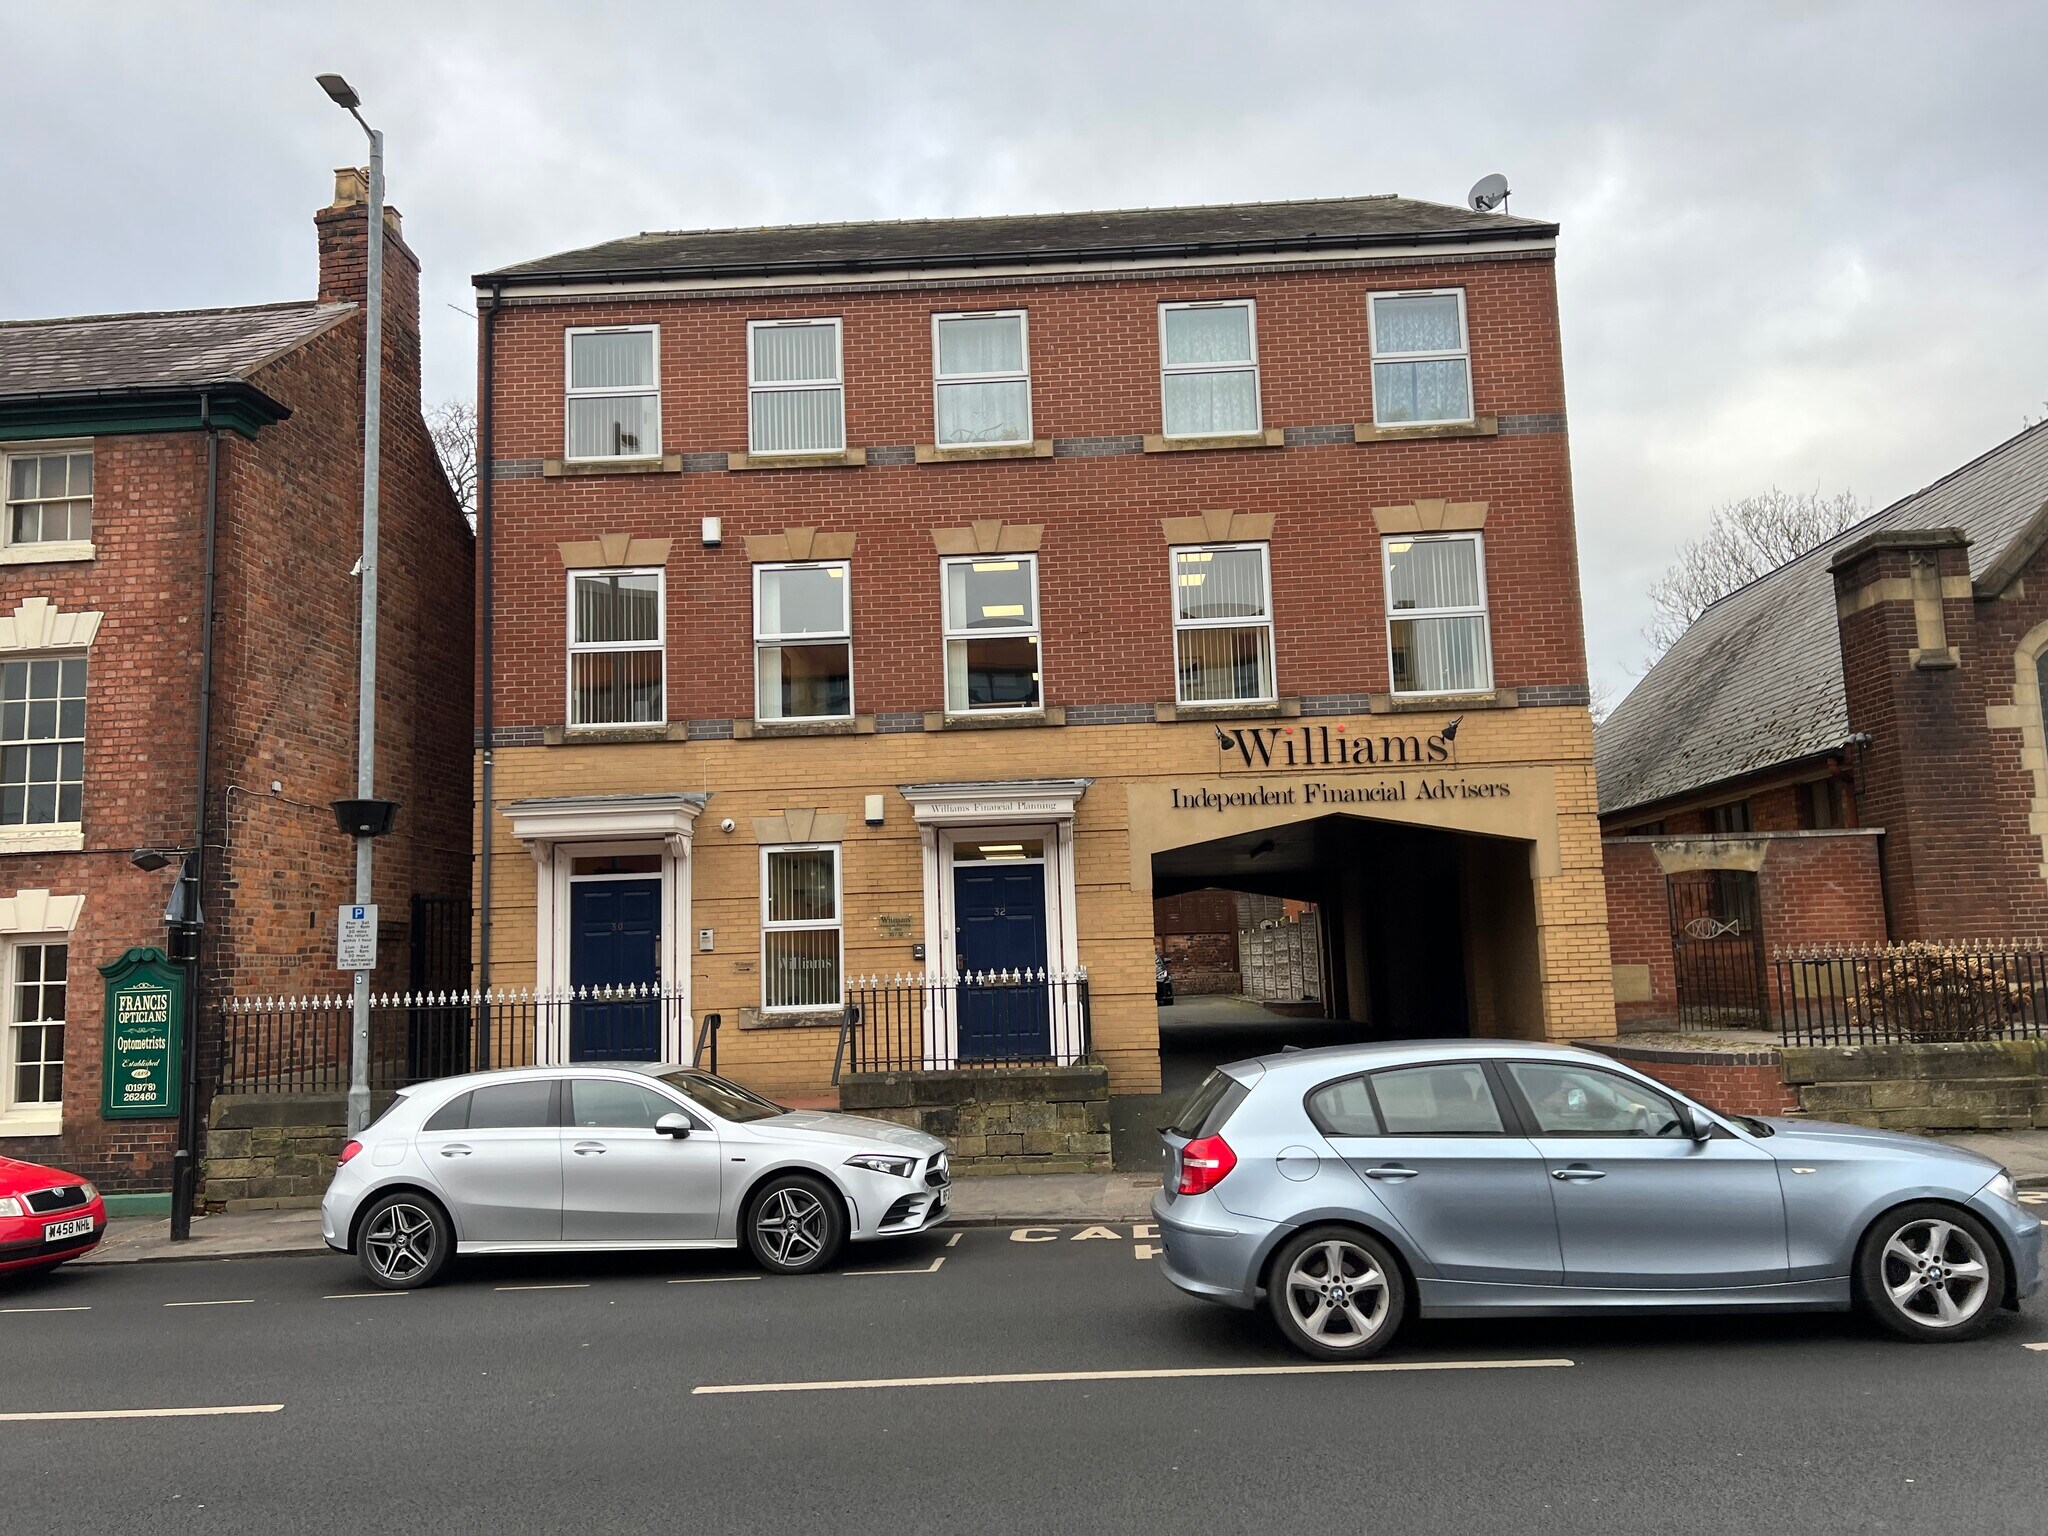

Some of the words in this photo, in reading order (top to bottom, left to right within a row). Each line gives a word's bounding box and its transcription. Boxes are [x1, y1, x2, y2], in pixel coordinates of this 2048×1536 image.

[1229, 725, 1449, 767] Williams
[1171, 786, 1295, 812] Independent
[1304, 781, 1406, 803] Financial
[1416, 778, 1511, 800] Advisers
[931, 804, 970, 813] Williams
[974, 802, 1013, 812] Financial
[1017, 801, 1056, 811] Planning
[355, 908, 363, 919] P
[994, 907, 1006, 916] 32
[611, 921, 624, 931] 30
[778, 957, 831, 969] Williams
[356, 976, 362, 984] 3
[118, 994, 168, 1012] FRANCIS
[118, 1010, 167, 1024] OPTICIANS
[117, 1035, 166, 1053] Optometrists
[121, 1059, 160, 1068] Established
[125, 1083, 156, 1092] (01978)
[123, 1092, 157, 1101] 262460
[49, 1222, 74, 1238] W458
